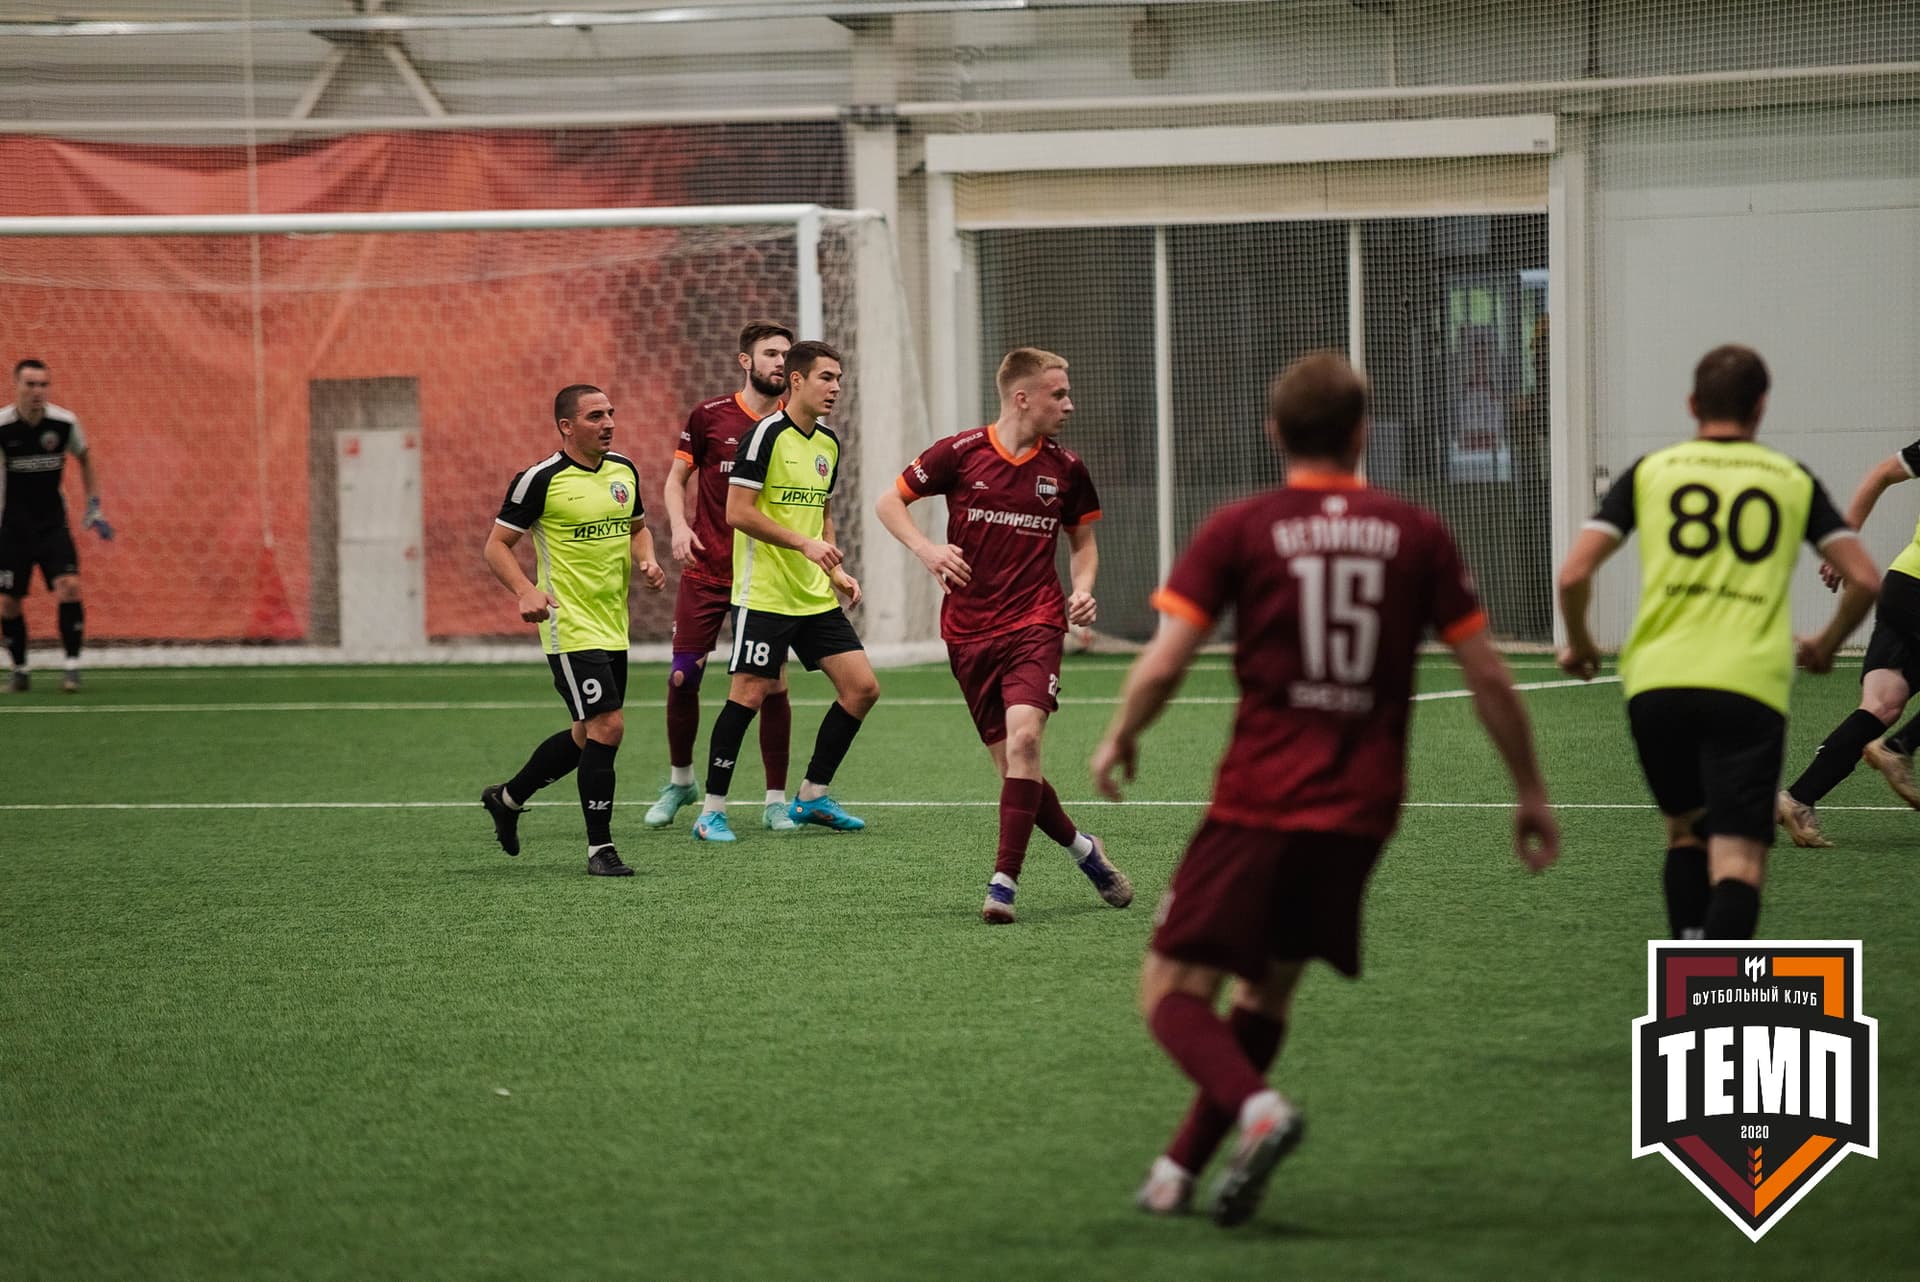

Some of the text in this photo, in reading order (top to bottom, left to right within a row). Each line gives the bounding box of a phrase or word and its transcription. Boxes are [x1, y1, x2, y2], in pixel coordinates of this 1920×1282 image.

[574, 521, 631, 538] ИРКУТС
[967, 508, 1058, 531] ПРОДИНВЕСТ
[1669, 484, 1781, 565] 80
[1288, 555, 1384, 683] 15
[745, 640, 770, 667] 18
[582, 678, 603, 704] 9
